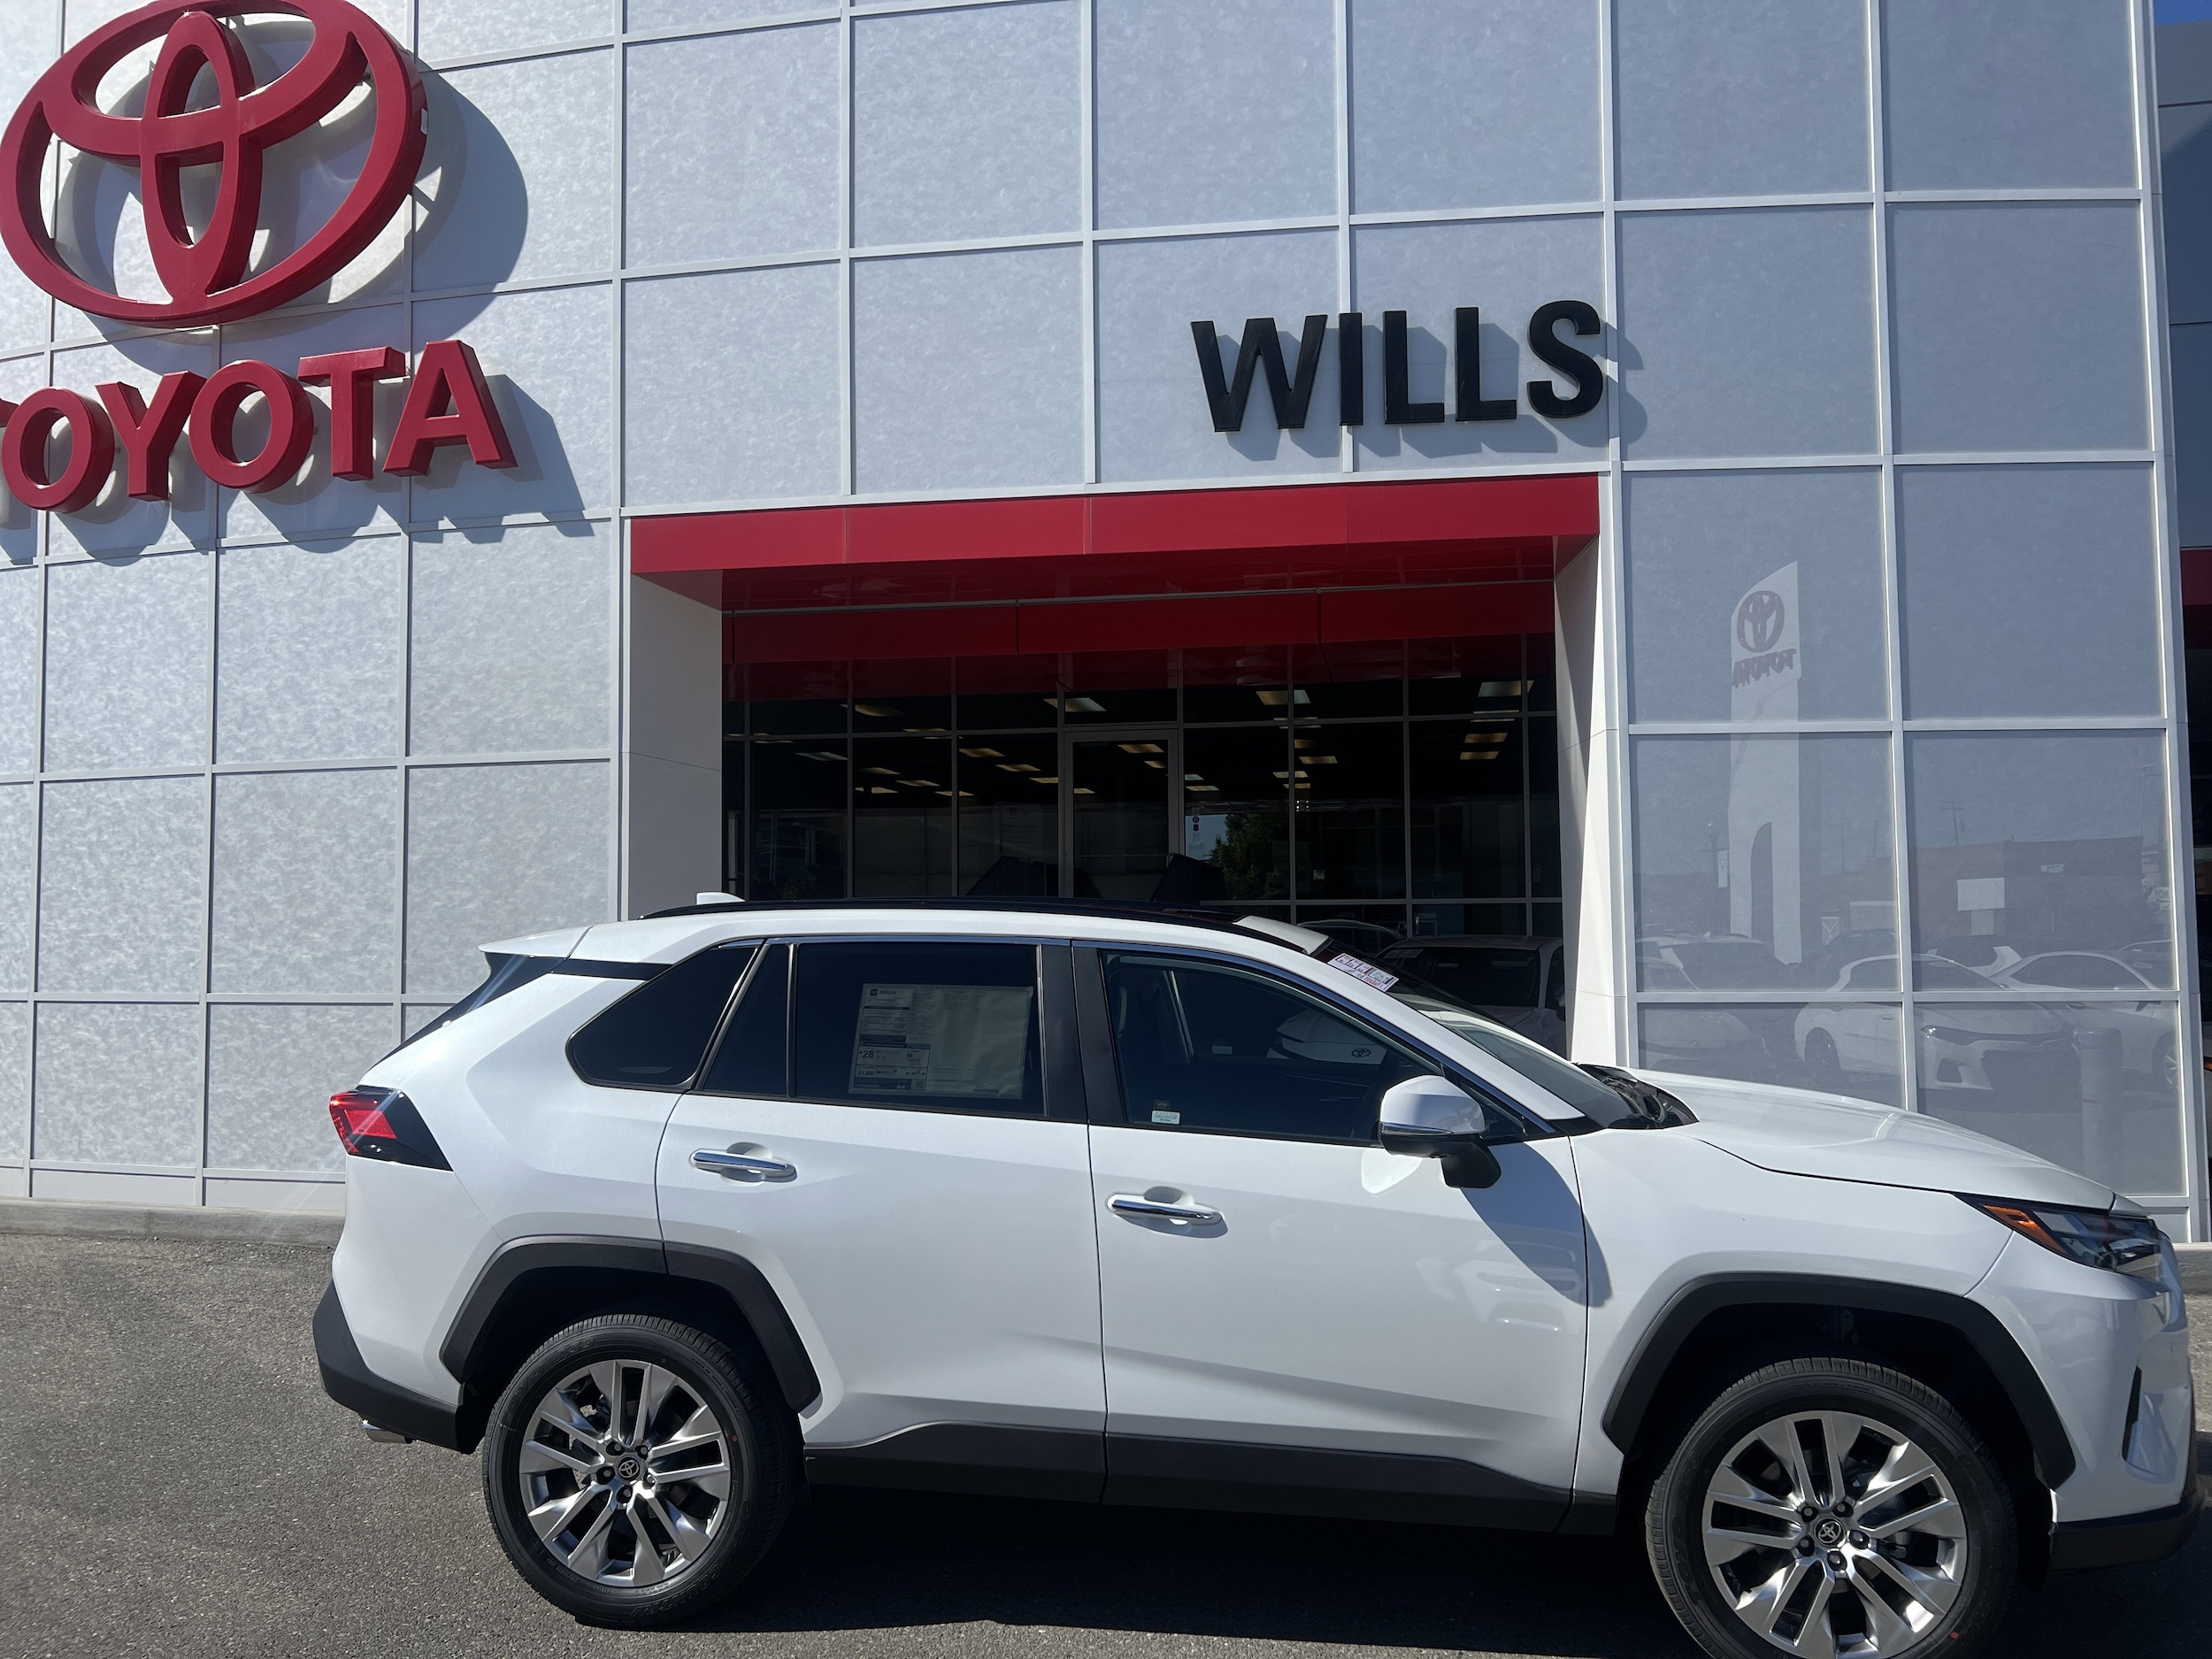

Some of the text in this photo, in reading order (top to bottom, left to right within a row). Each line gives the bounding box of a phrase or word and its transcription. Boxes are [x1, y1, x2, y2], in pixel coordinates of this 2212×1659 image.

[0, 339, 518, 512] OYOTA
[1190, 299, 1604, 433] WILLS
[862, 1049, 875, 1059] 28
